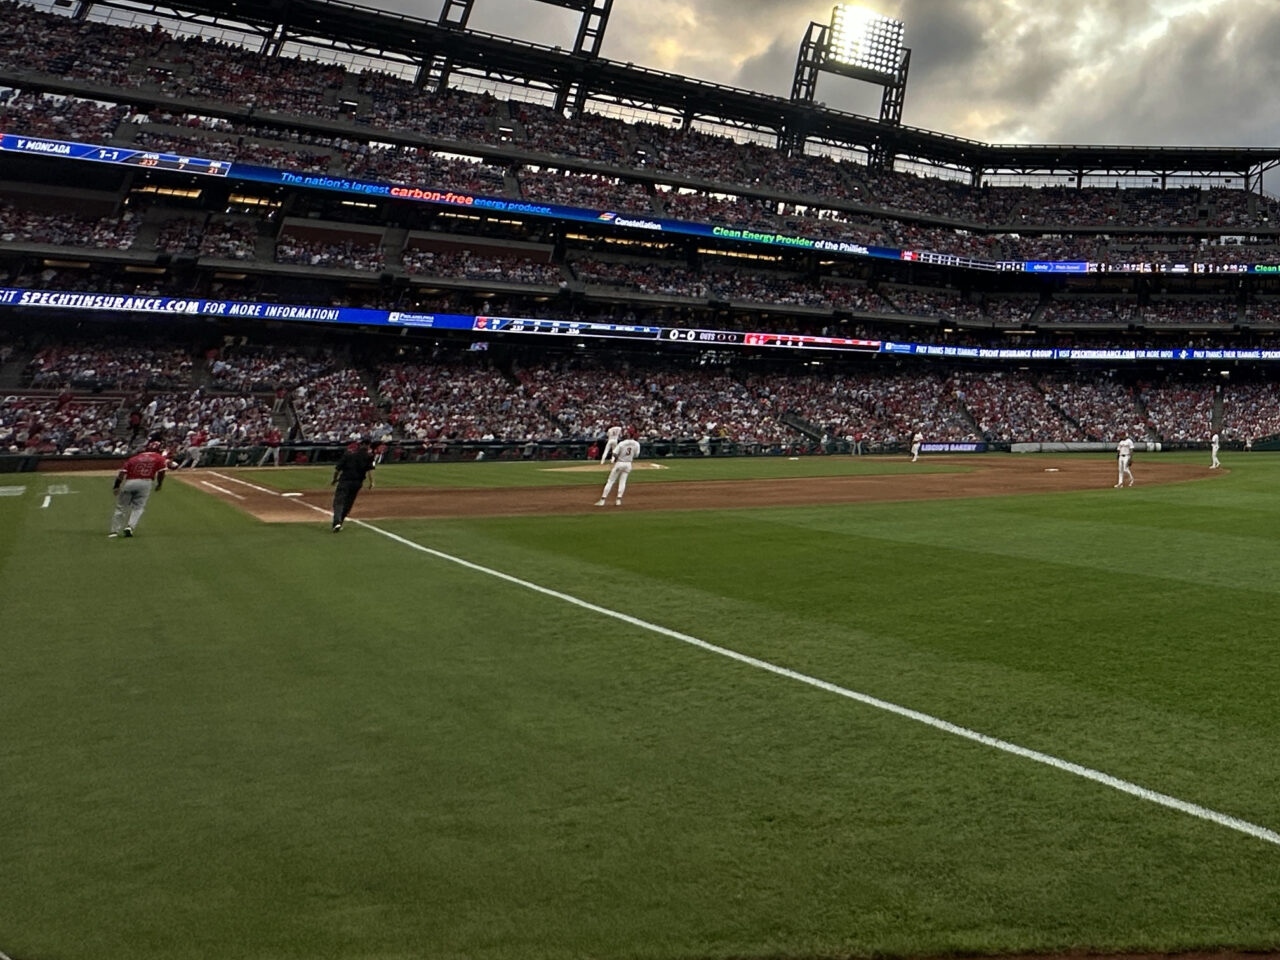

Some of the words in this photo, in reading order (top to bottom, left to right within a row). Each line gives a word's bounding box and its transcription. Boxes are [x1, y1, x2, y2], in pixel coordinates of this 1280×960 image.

[26, 140, 71, 154] MONCADA
[99, 149, 119, 160] 1-1
[281, 172, 303, 184] The
[304, 177, 350, 189] nation's
[351, 181, 390, 194] largest
[390, 185, 474, 205] carbon-free
[474, 197, 507, 210] energy
[614, 217, 662, 231] Constellation
[712, 226, 740, 238] Clean
[742, 230, 774, 243] Energy
[775, 235, 814, 247] Provider
[814, 240, 824, 249] of
[825, 241, 838, 250] the
[839, 243, 869, 255] Phillies.
[1254, 264, 1276, 272] Clean
[20, 292, 200, 313] SPECHTINSURANCE.COM
[203, 302, 225, 314] FOR
[229, 303, 262, 317] MORE
[265, 306, 340, 321] INFORMATION!
[980, 349, 999, 357] SPECHT
[999, 350, 1031, 358] INSURANCE
[1032, 350, 1053, 358] GROUP
[1070, 350, 1136, 359] SPECHTINSURANCE.COM
[1261, 351, 1280, 359] SPECHT
[625, 447, 632, 456] 3
